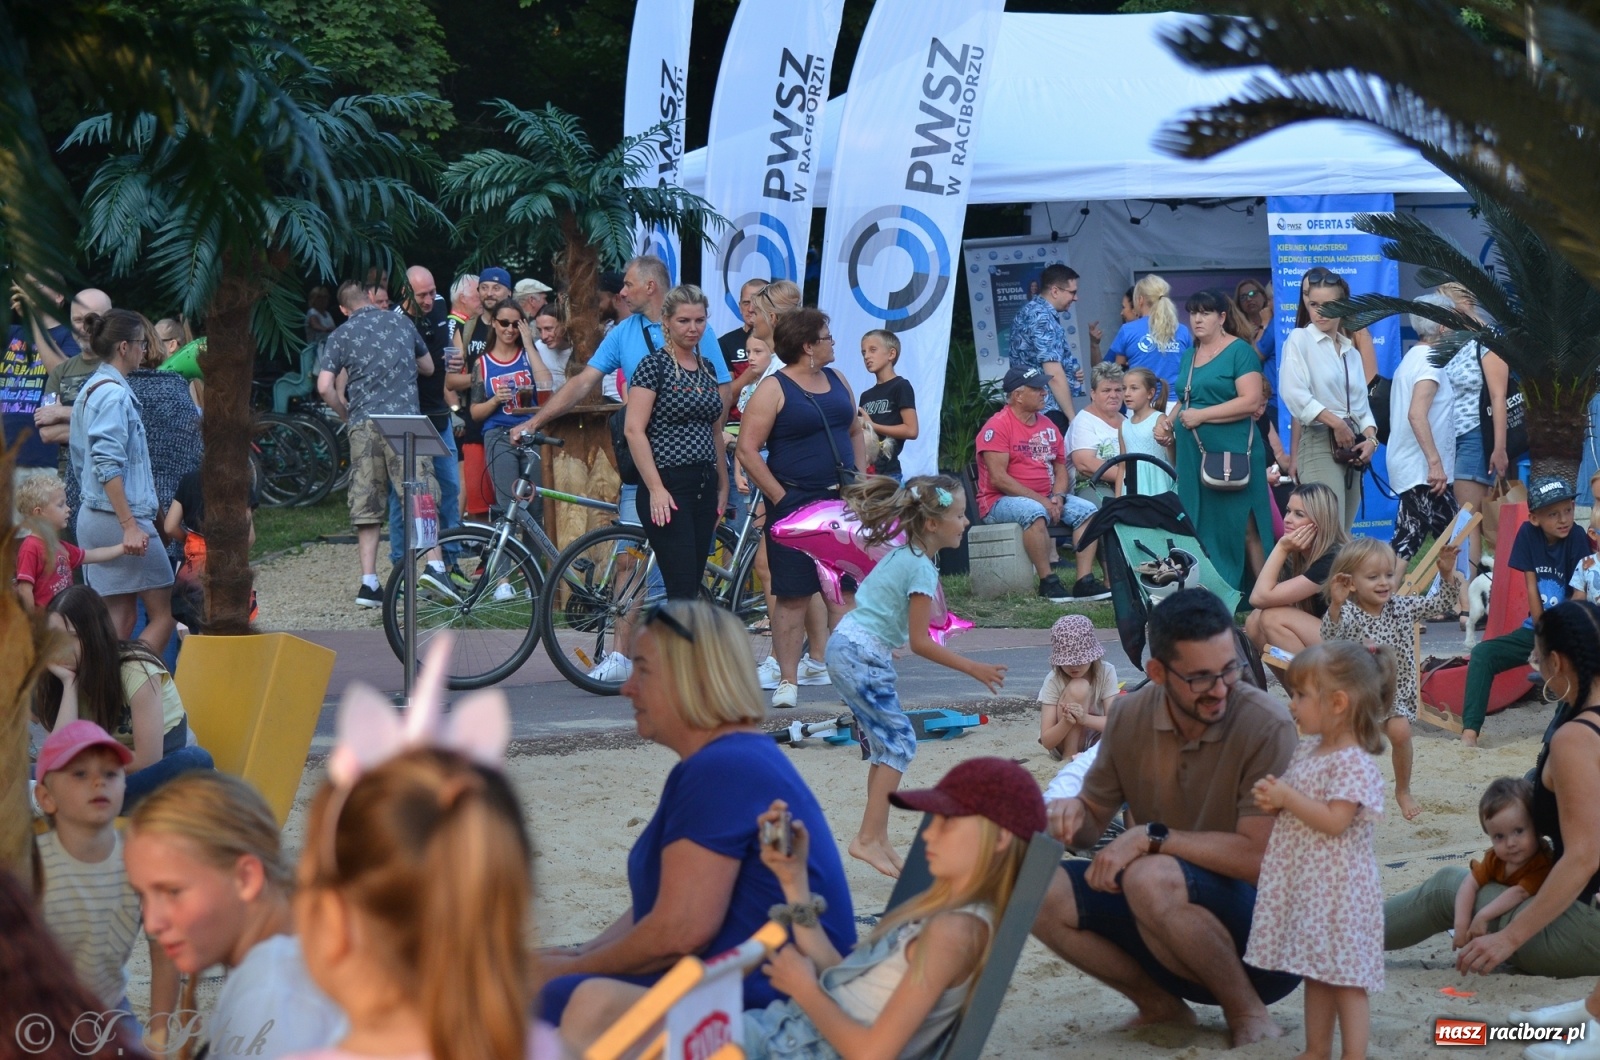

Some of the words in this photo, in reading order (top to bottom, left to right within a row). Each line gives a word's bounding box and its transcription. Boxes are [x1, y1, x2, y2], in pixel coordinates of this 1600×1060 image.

[763, 47, 814, 202] PWSZ
[905, 37, 970, 195] PWSZ
[952, 46, 984, 166] RACIBORZU
[1307, 219, 1343, 229] OFERTA
[1313, 255, 1336, 263] STUDIA
[1540, 482, 1563, 494] MARVEL
